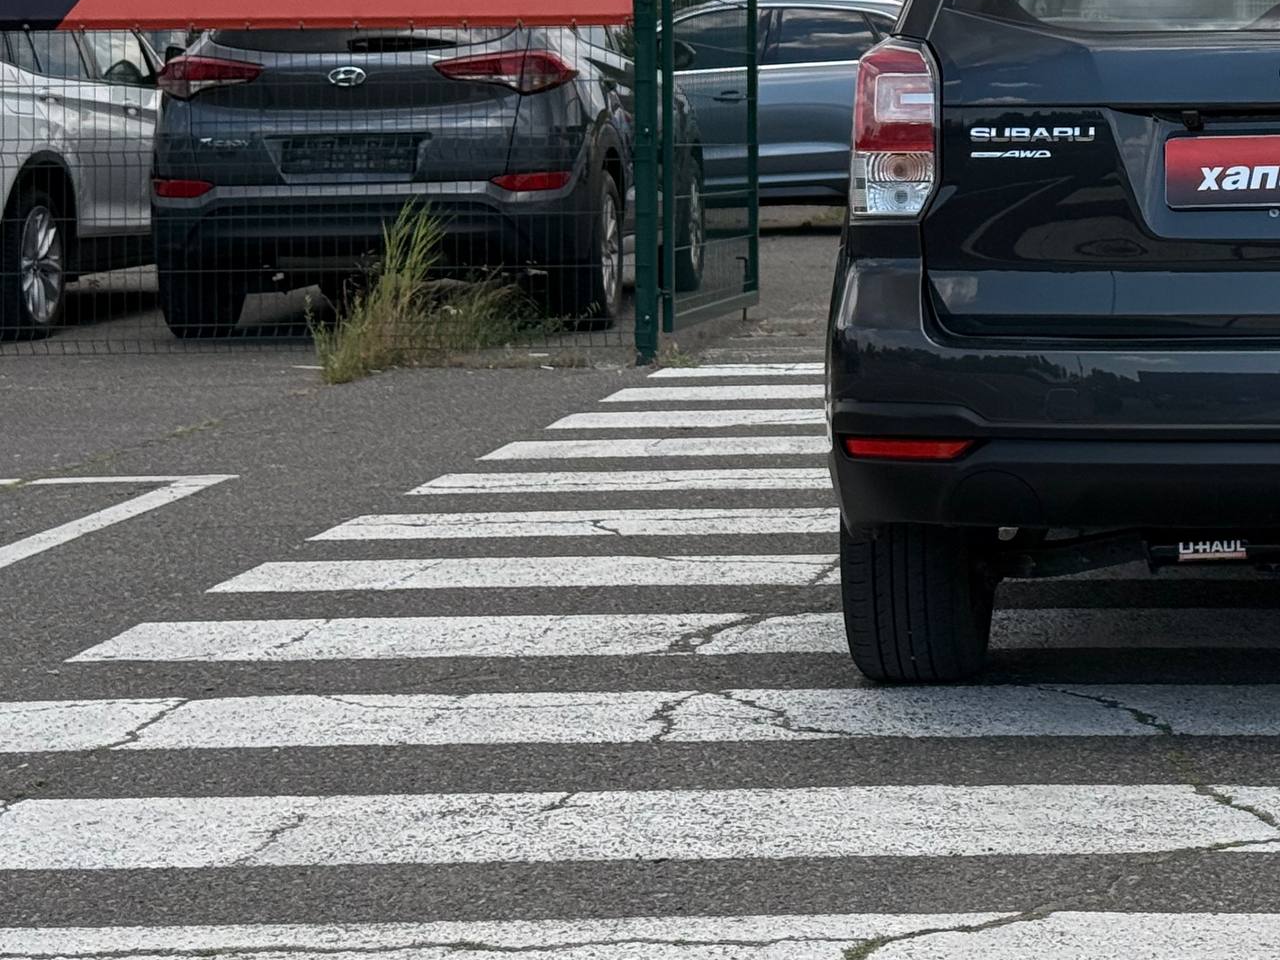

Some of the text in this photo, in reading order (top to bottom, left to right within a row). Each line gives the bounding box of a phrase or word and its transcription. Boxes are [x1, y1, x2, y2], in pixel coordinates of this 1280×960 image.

[970, 127, 1095, 142] SUBARU
[1001, 150, 1052, 158] AWD
[1179, 540, 1246, 553] U-HAUL
